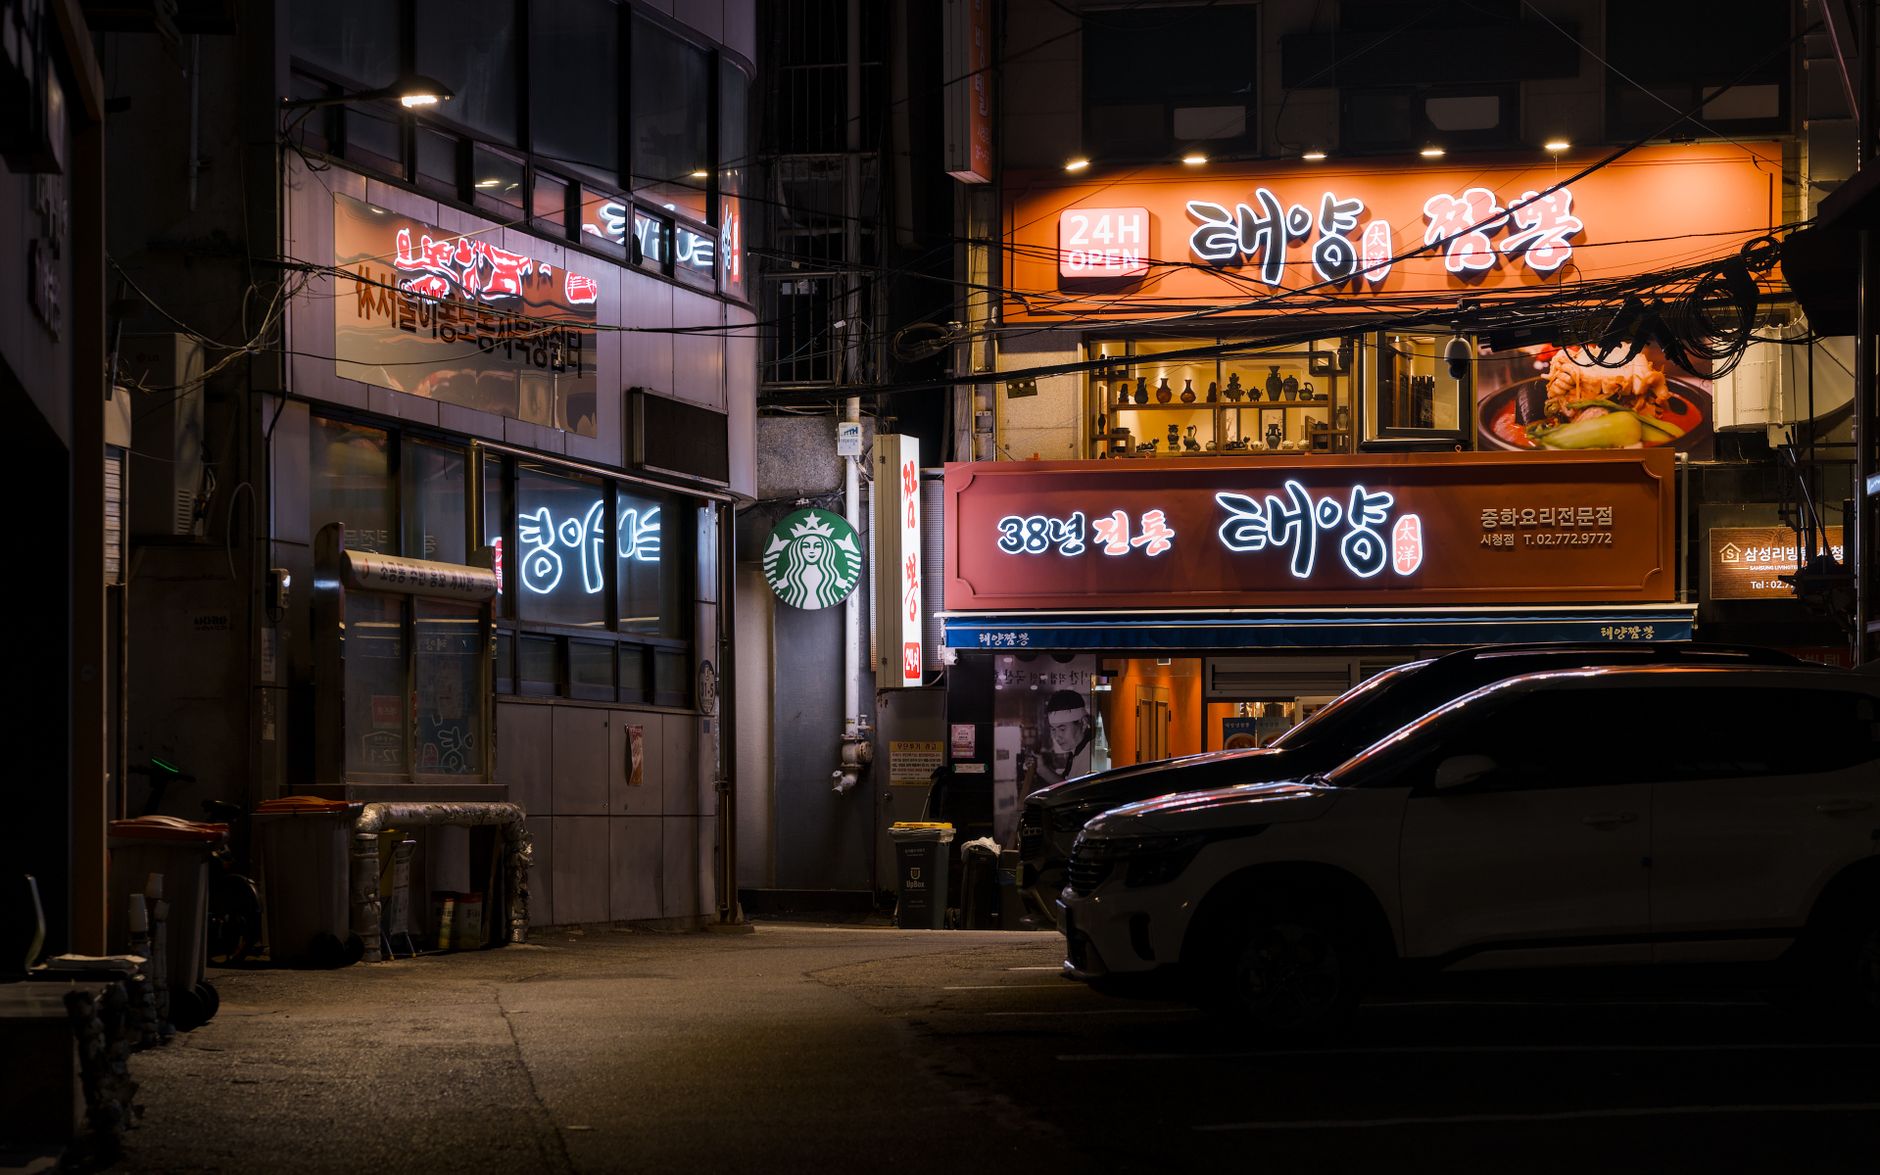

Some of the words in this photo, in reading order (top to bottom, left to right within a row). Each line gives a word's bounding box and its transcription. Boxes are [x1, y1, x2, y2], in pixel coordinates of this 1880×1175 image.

[1069, 214, 1140, 245] 24H
[1186, 188, 1366, 286] 태양
[1424, 187, 1583, 274] 짬뽕
[1067, 247, 1140, 271] OPEN
[997, 510, 1086, 556] 38년
[1092, 510, 1176, 556] 전통
[1215, 480, 1394, 578] 태양
[1480, 506, 1613, 529] 중화요리전문점
[1396, 518, 1419, 570] 太洋
[1480, 533, 1515, 546] 시청점
